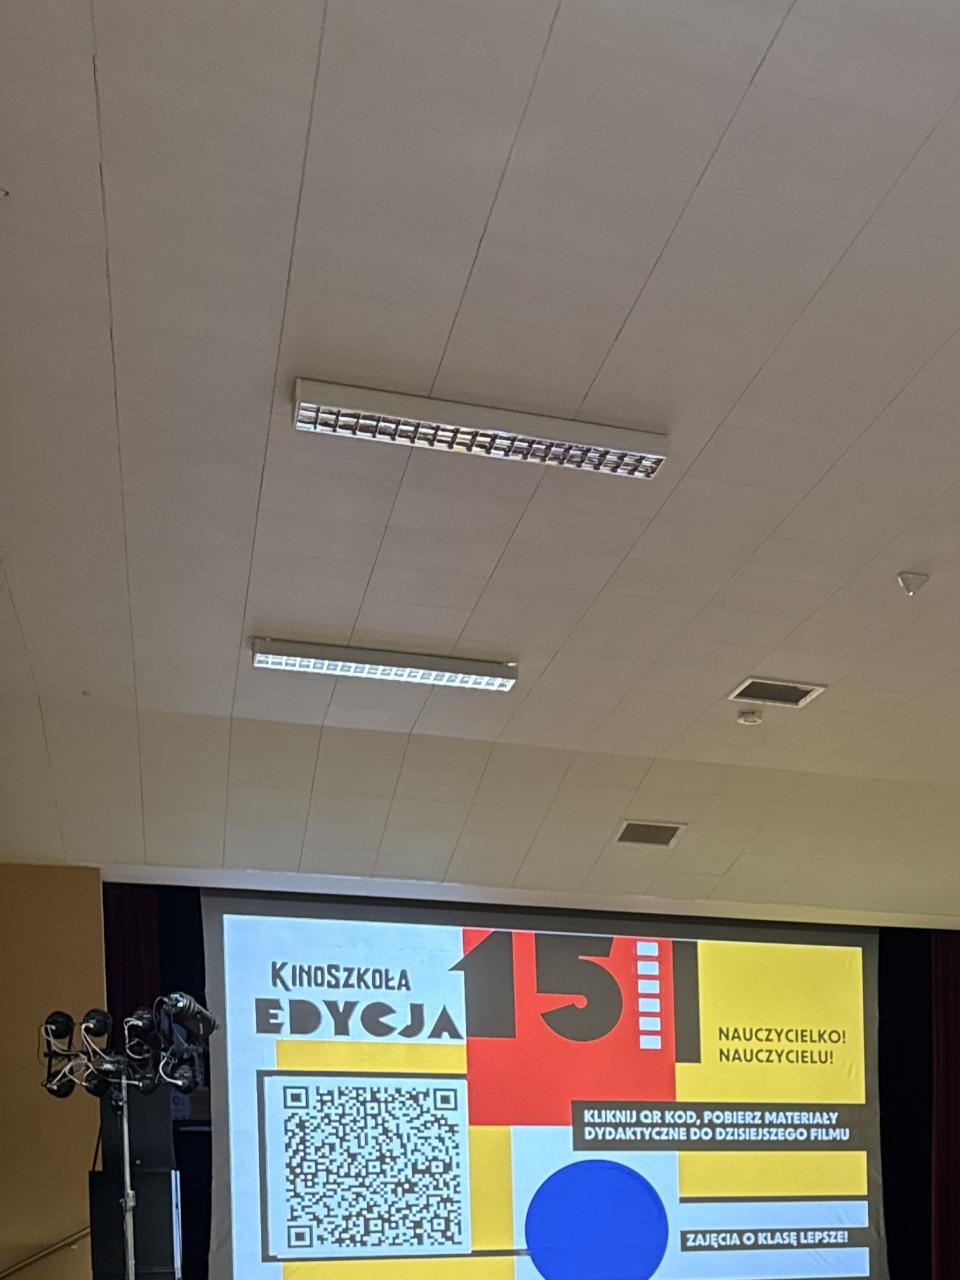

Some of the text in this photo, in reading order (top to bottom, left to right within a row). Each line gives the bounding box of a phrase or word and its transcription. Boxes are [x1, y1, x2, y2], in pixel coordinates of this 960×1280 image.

[255, 930, 624, 1042] EDYCJA 15
[718, 1026, 847, 1044] NAUCZYCIELKO!
[719, 1048, 834, 1065] NAUCZYCIELU!
[583, 1109, 839, 1126] KLIKNIJ QR KOD, POBIERZ MATERIAŁY
[584, 1126, 850, 1142] DYDAKTYCZNE DO DZISIEJSZEGO FILMU
[686, 1230, 849, 1248] ZAJĘCIA O KLASĘ LEPSZE!
